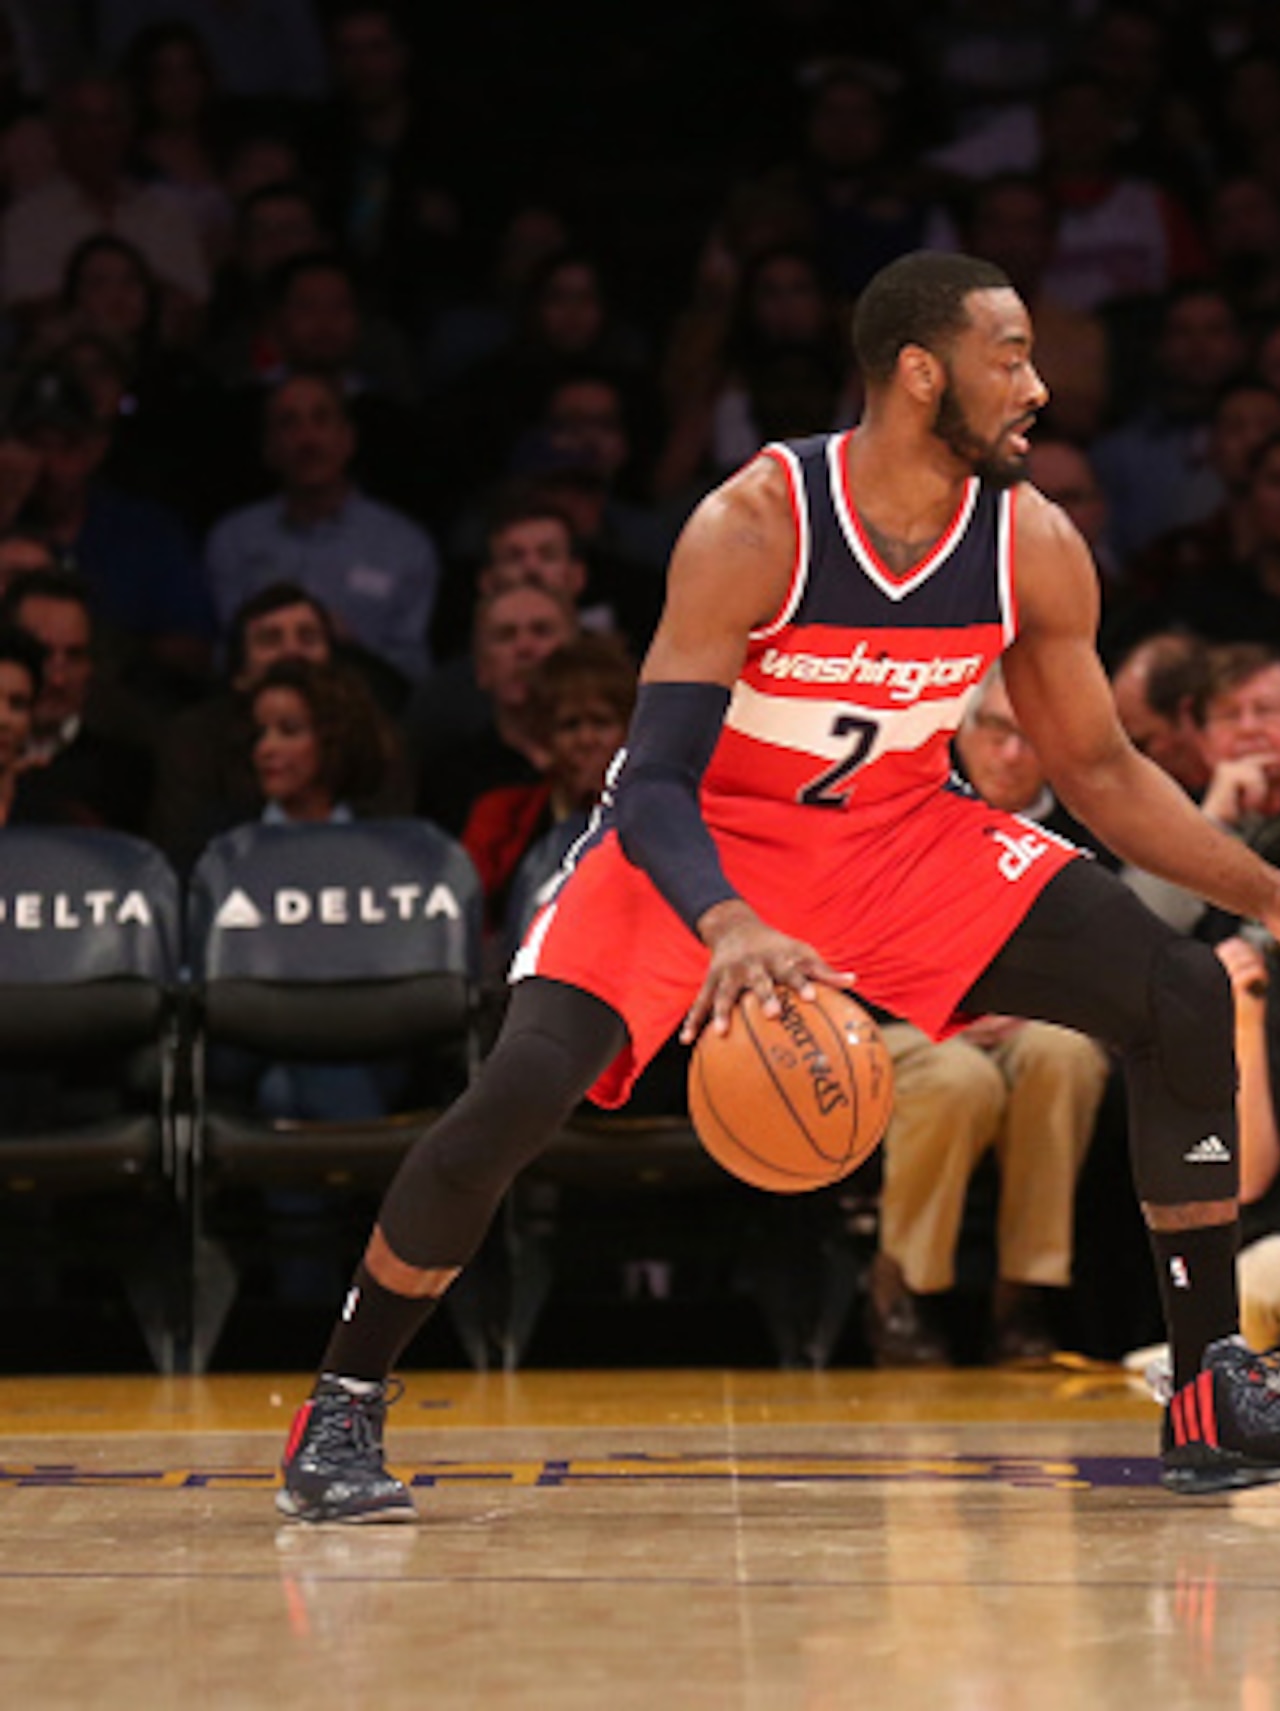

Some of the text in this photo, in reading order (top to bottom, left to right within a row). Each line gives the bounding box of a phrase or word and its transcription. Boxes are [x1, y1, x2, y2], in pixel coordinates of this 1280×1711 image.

[760, 641, 983, 701] washington
[799, 715, 879, 806] 2
[0, 890, 151, 929] ELTA
[274, 884, 460, 925] DELTA
[778, 988, 849, 1115] SPALDIN
